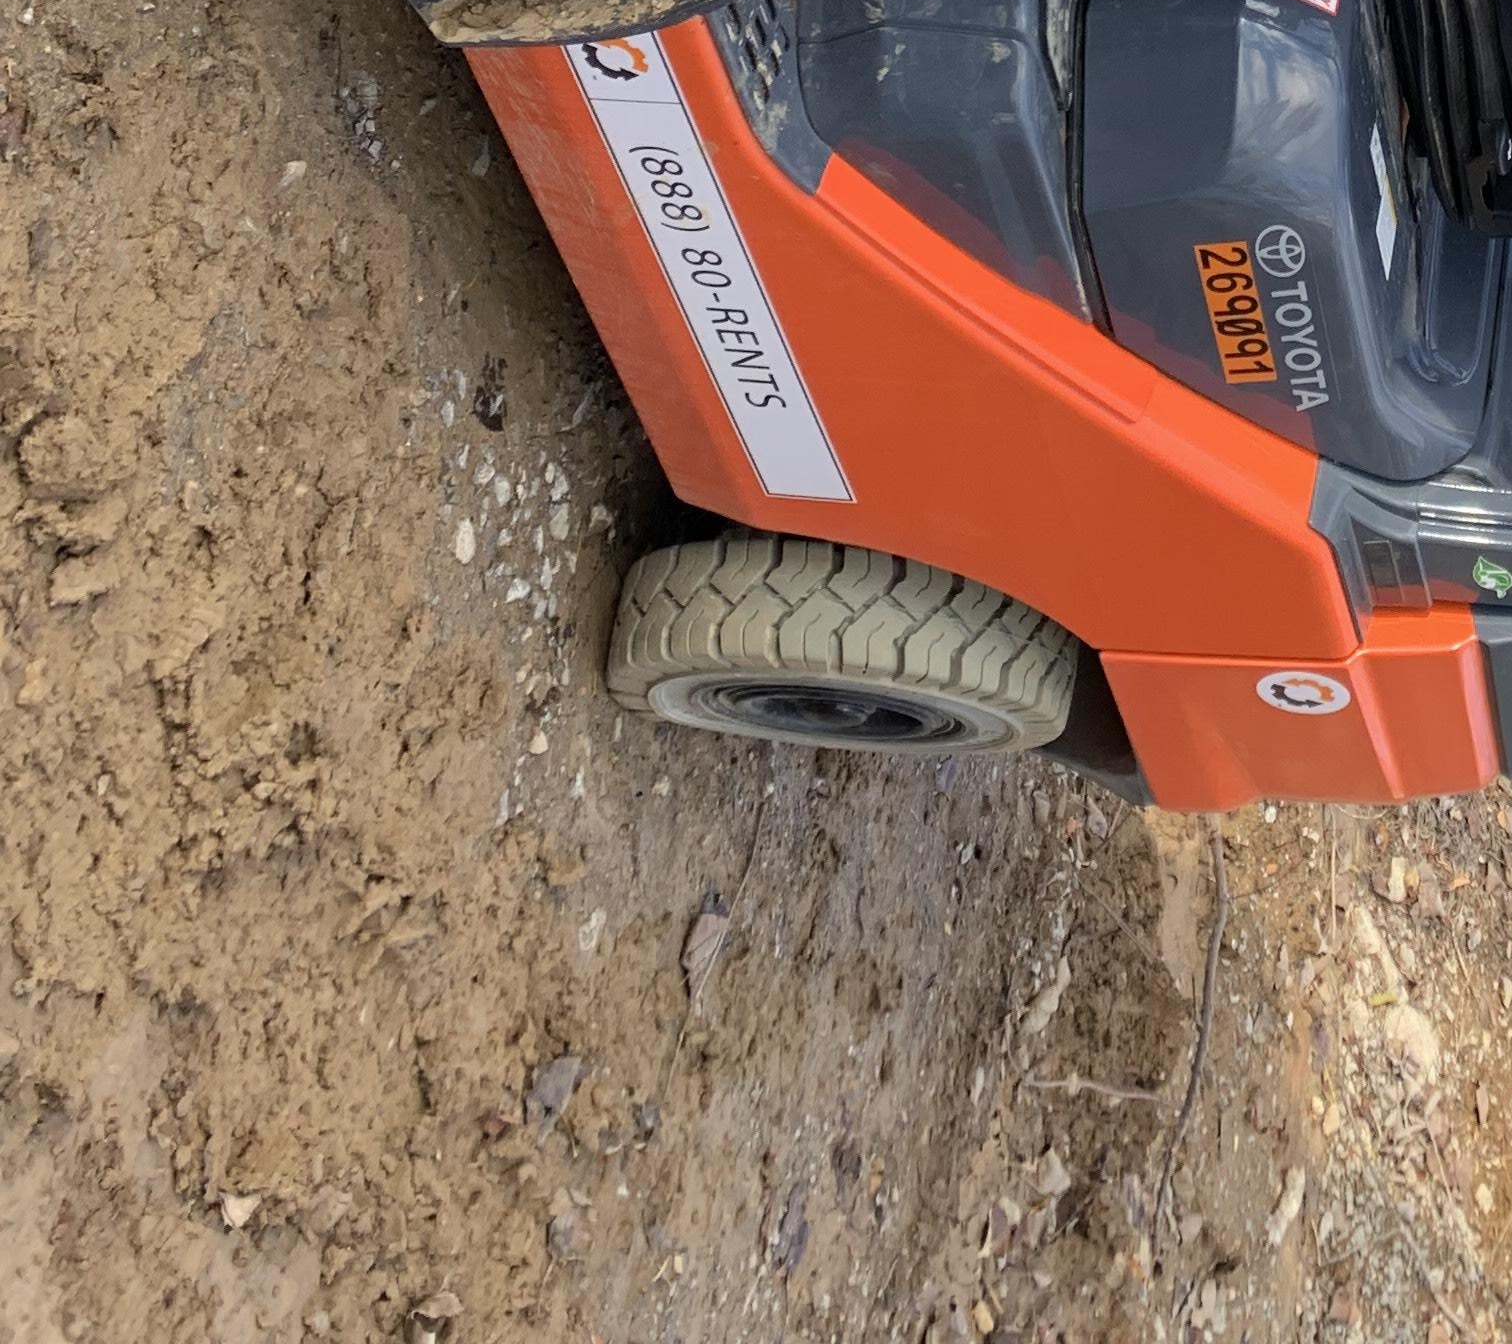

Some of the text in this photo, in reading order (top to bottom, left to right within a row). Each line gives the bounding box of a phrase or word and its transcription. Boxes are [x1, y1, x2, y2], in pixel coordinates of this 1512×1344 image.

[629, 145, 787, 409] (888) 80-RENTS
[1196, 246, 1273, 378] 269091
[1270, 281, 1330, 412] TOYOTA
